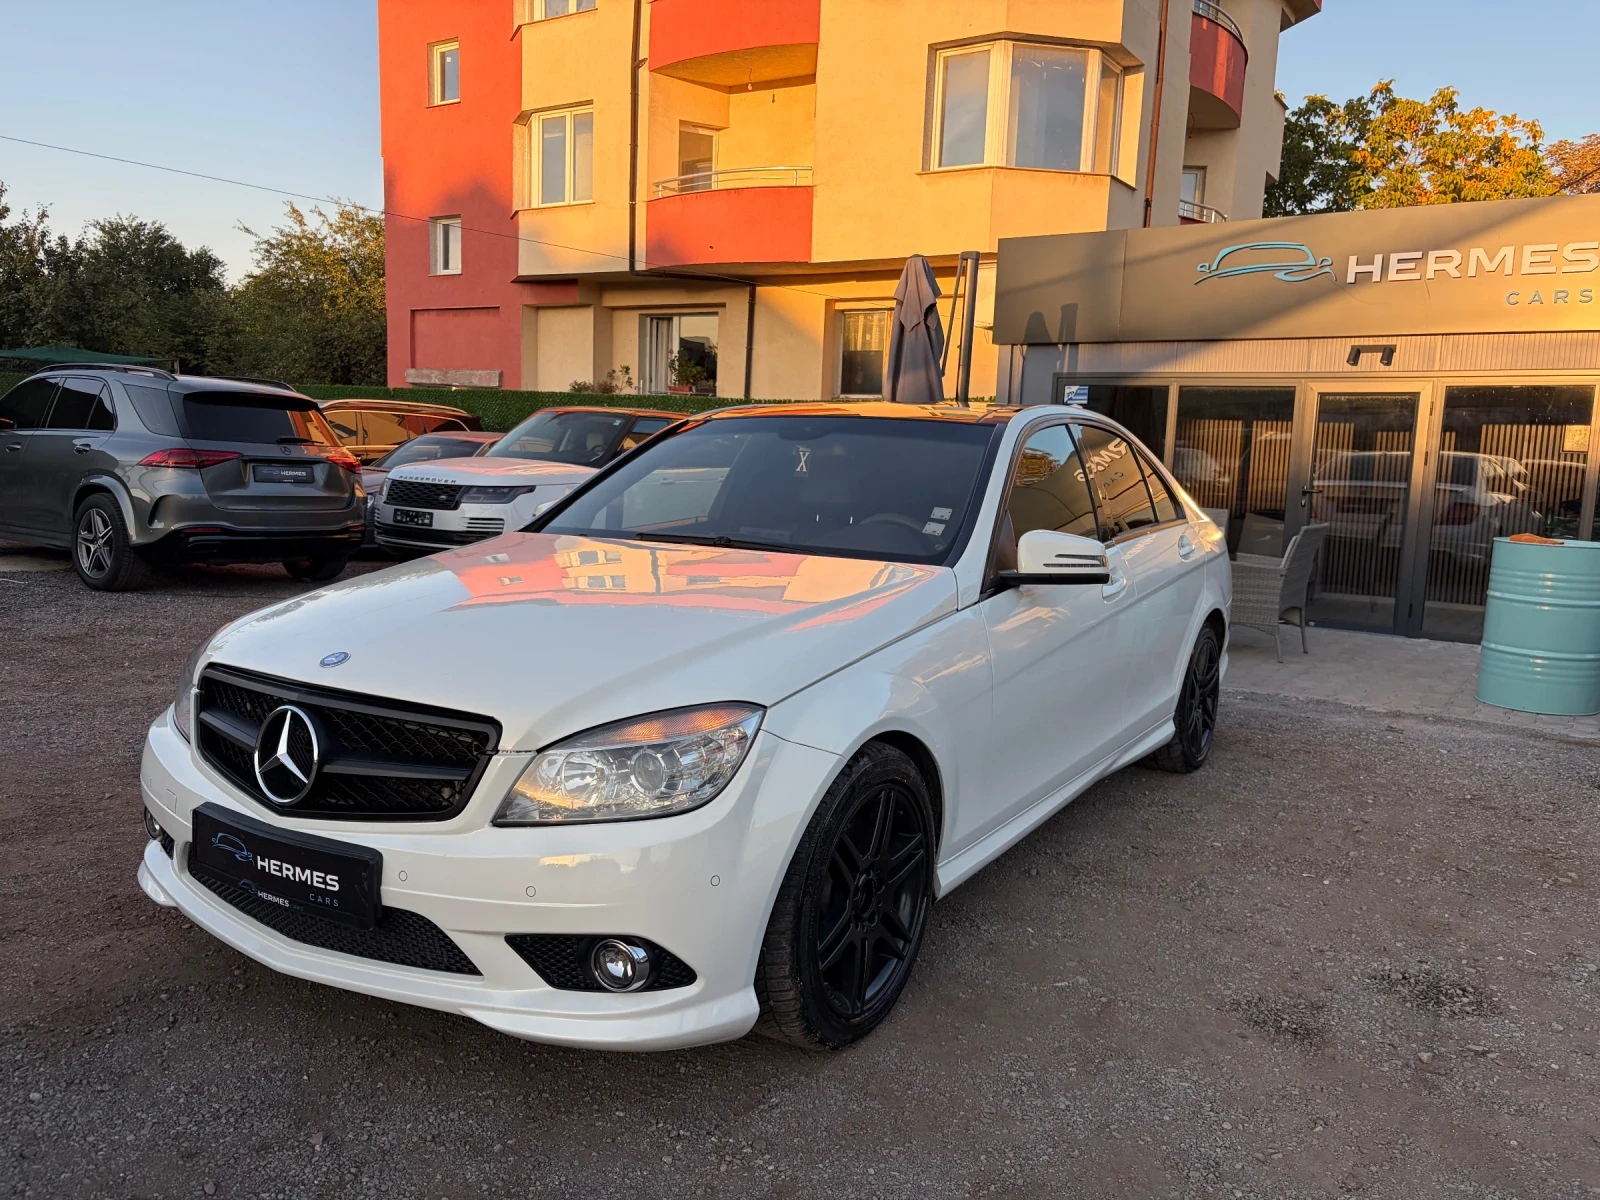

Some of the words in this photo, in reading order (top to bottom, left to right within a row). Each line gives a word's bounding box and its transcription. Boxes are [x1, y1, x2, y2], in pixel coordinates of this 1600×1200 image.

[1346, 241, 1600, 284] HERMES
[1505, 288, 1594, 306] CARS
[256, 855, 340, 892] HERMES
[257, 890, 290, 908] HERMES
[309, 893, 339, 907] CARS
